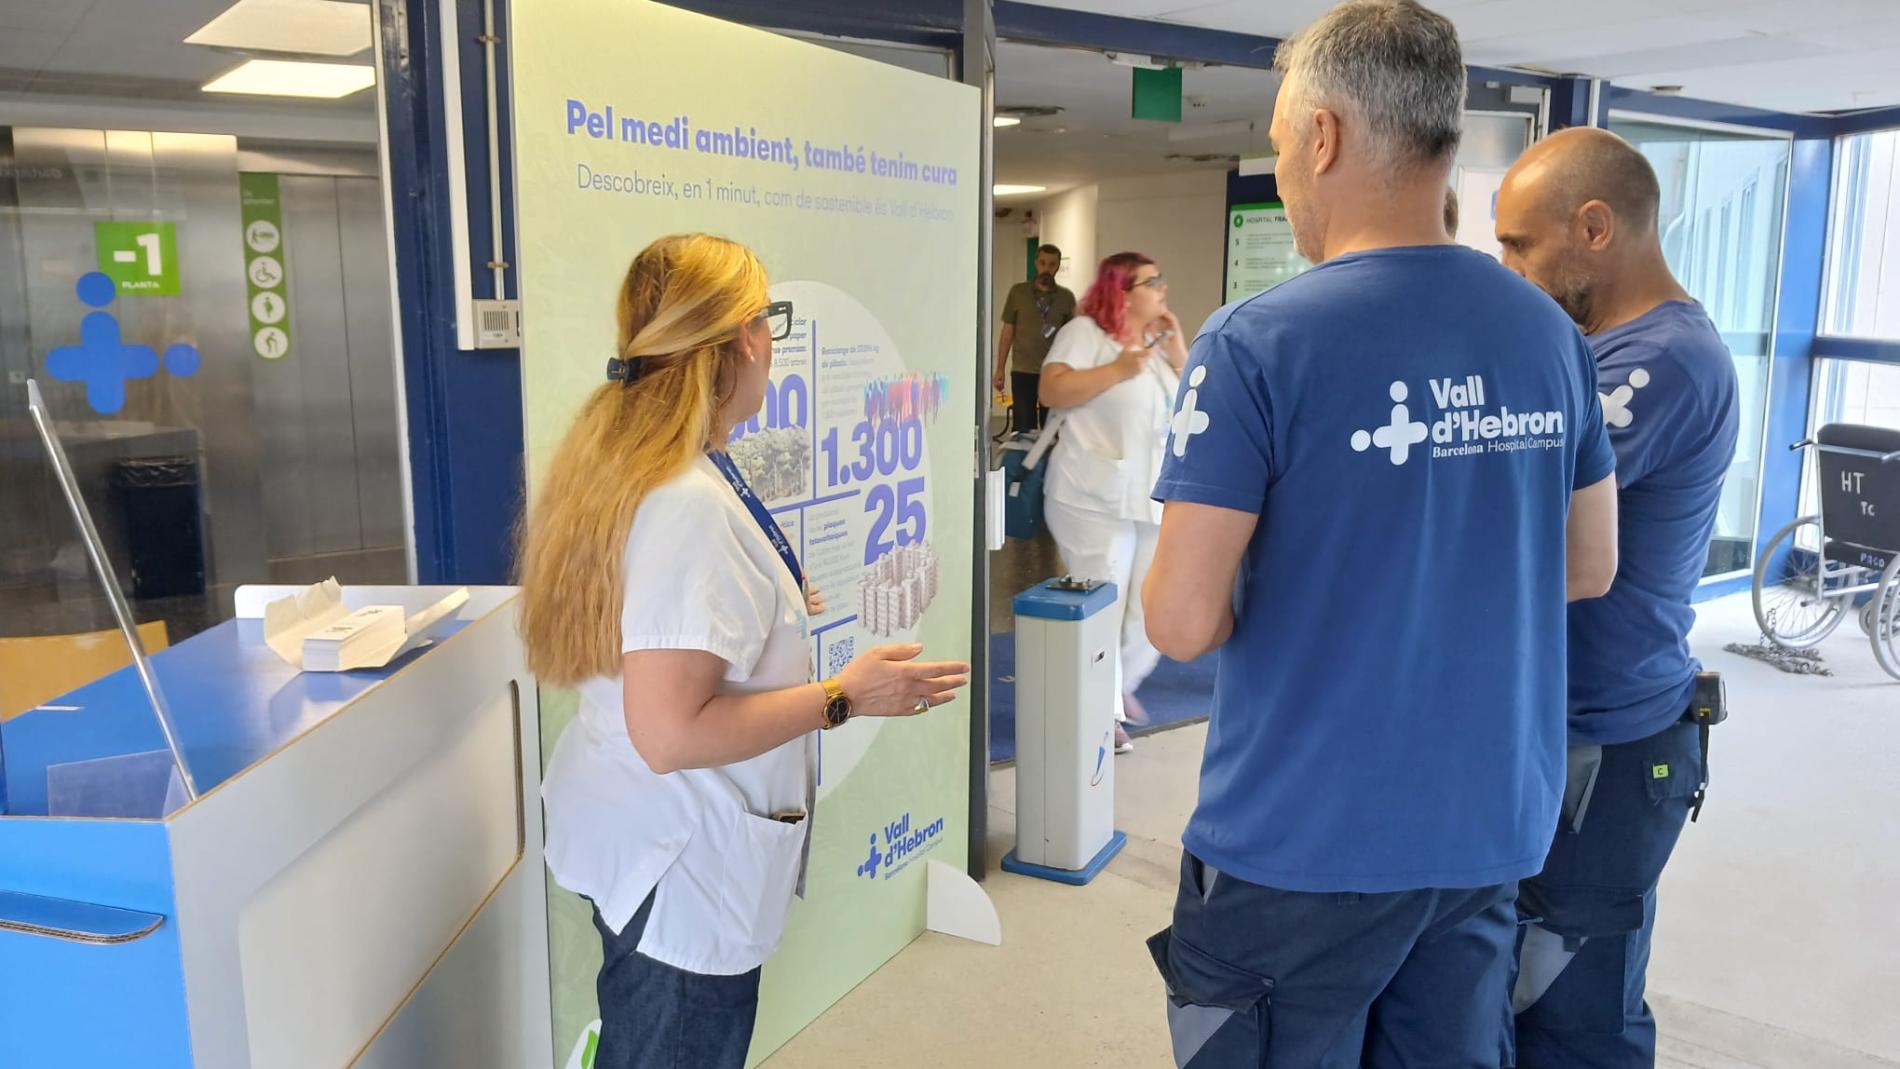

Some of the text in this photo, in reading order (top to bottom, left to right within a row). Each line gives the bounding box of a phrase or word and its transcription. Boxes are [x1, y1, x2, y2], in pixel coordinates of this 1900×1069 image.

[566, 99, 958, 186] Pel medi ambient, també tenim cura
[577, 163, 679, 201] Descobreix,
[683, 182, 702, 199] en
[706, 177, 713, 200] 1
[716, 181, 761, 208] minut,
[764, 190, 793, 207] com
[796, 188, 812, 209] de
[113, 232, 162, 276] -1
[122, 281, 161, 289] PLANTA
[1428, 374, 1485, 410] Vall
[1431, 406, 1564, 444] d'Hebron
[821, 417, 923, 487] 1.300
[1432, 436, 1564, 458] Barcelona Hospital Campus
[1841, 470, 1865, 495] HT
[864, 476, 926, 566] 25
[884, 812, 909, 845] Vall
[885, 817, 944, 868] d'Hebron
